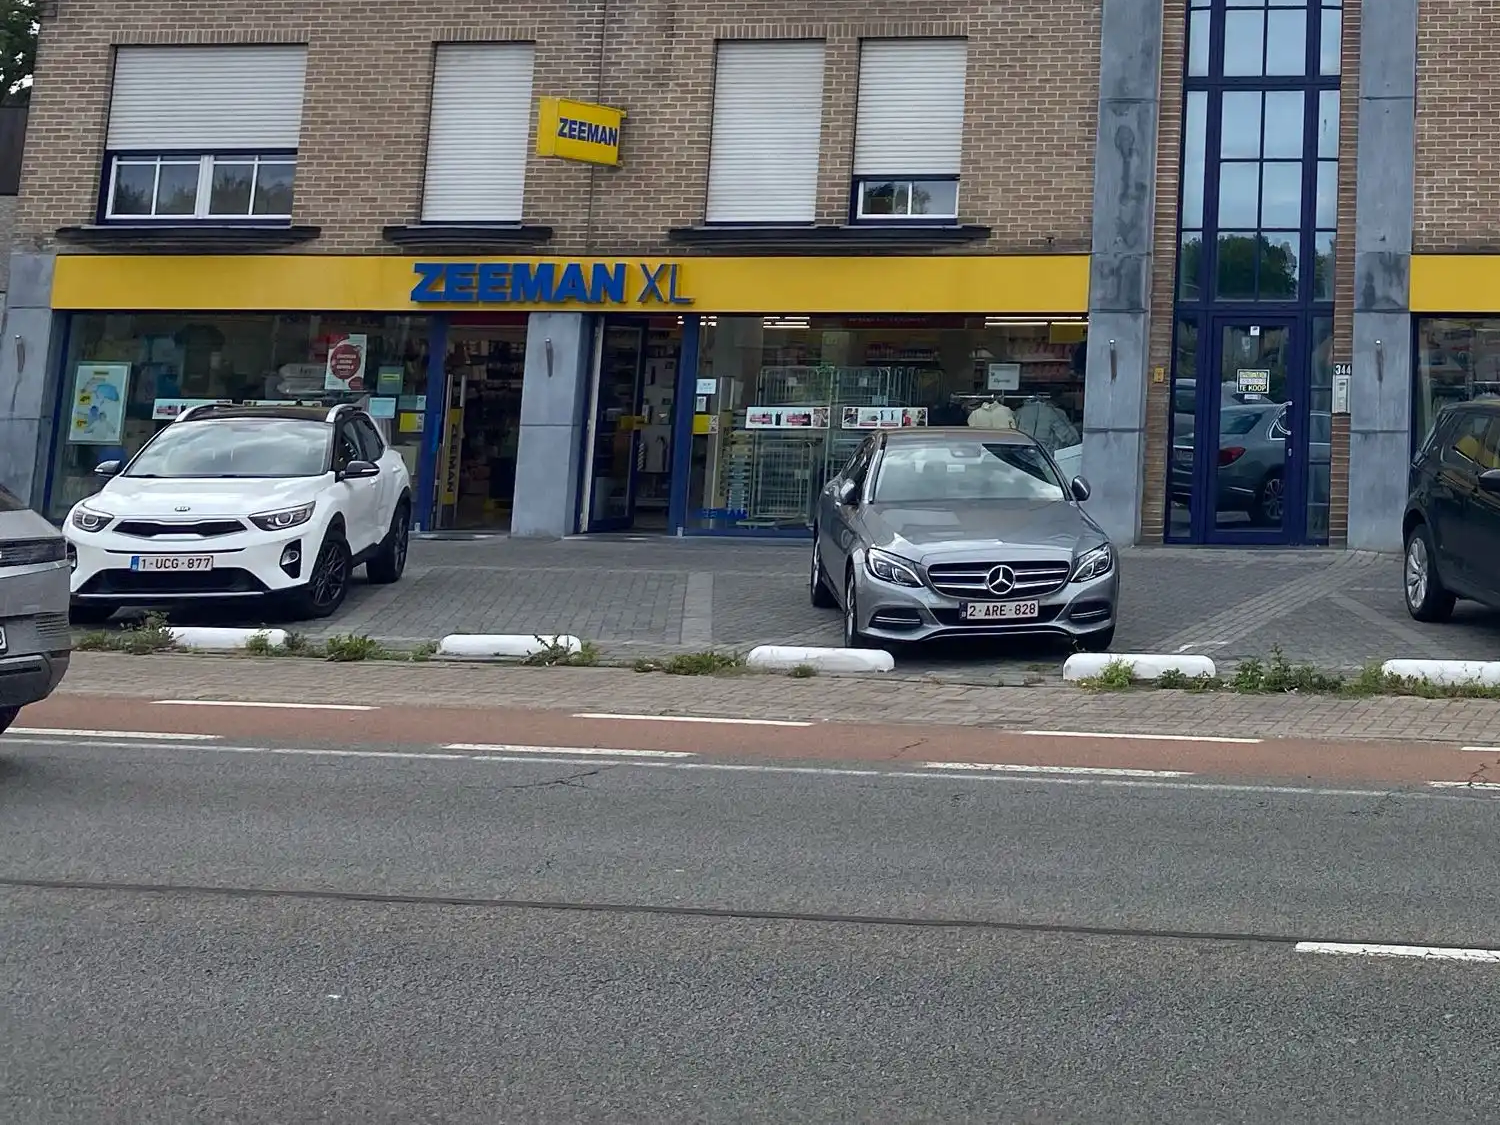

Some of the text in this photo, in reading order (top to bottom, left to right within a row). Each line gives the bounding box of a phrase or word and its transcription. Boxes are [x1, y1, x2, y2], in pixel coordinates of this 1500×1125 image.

[558, 117, 618, 147] ZEEMAN
[410, 262, 696, 304] ZEEMAN XL
[1335, 364, 1351, 375] 344
[1248, 384, 1267, 392] KOOP
[141, 558, 211, 570] 1-UCG-877
[968, 603, 1037, 617] 2-ARE-828
